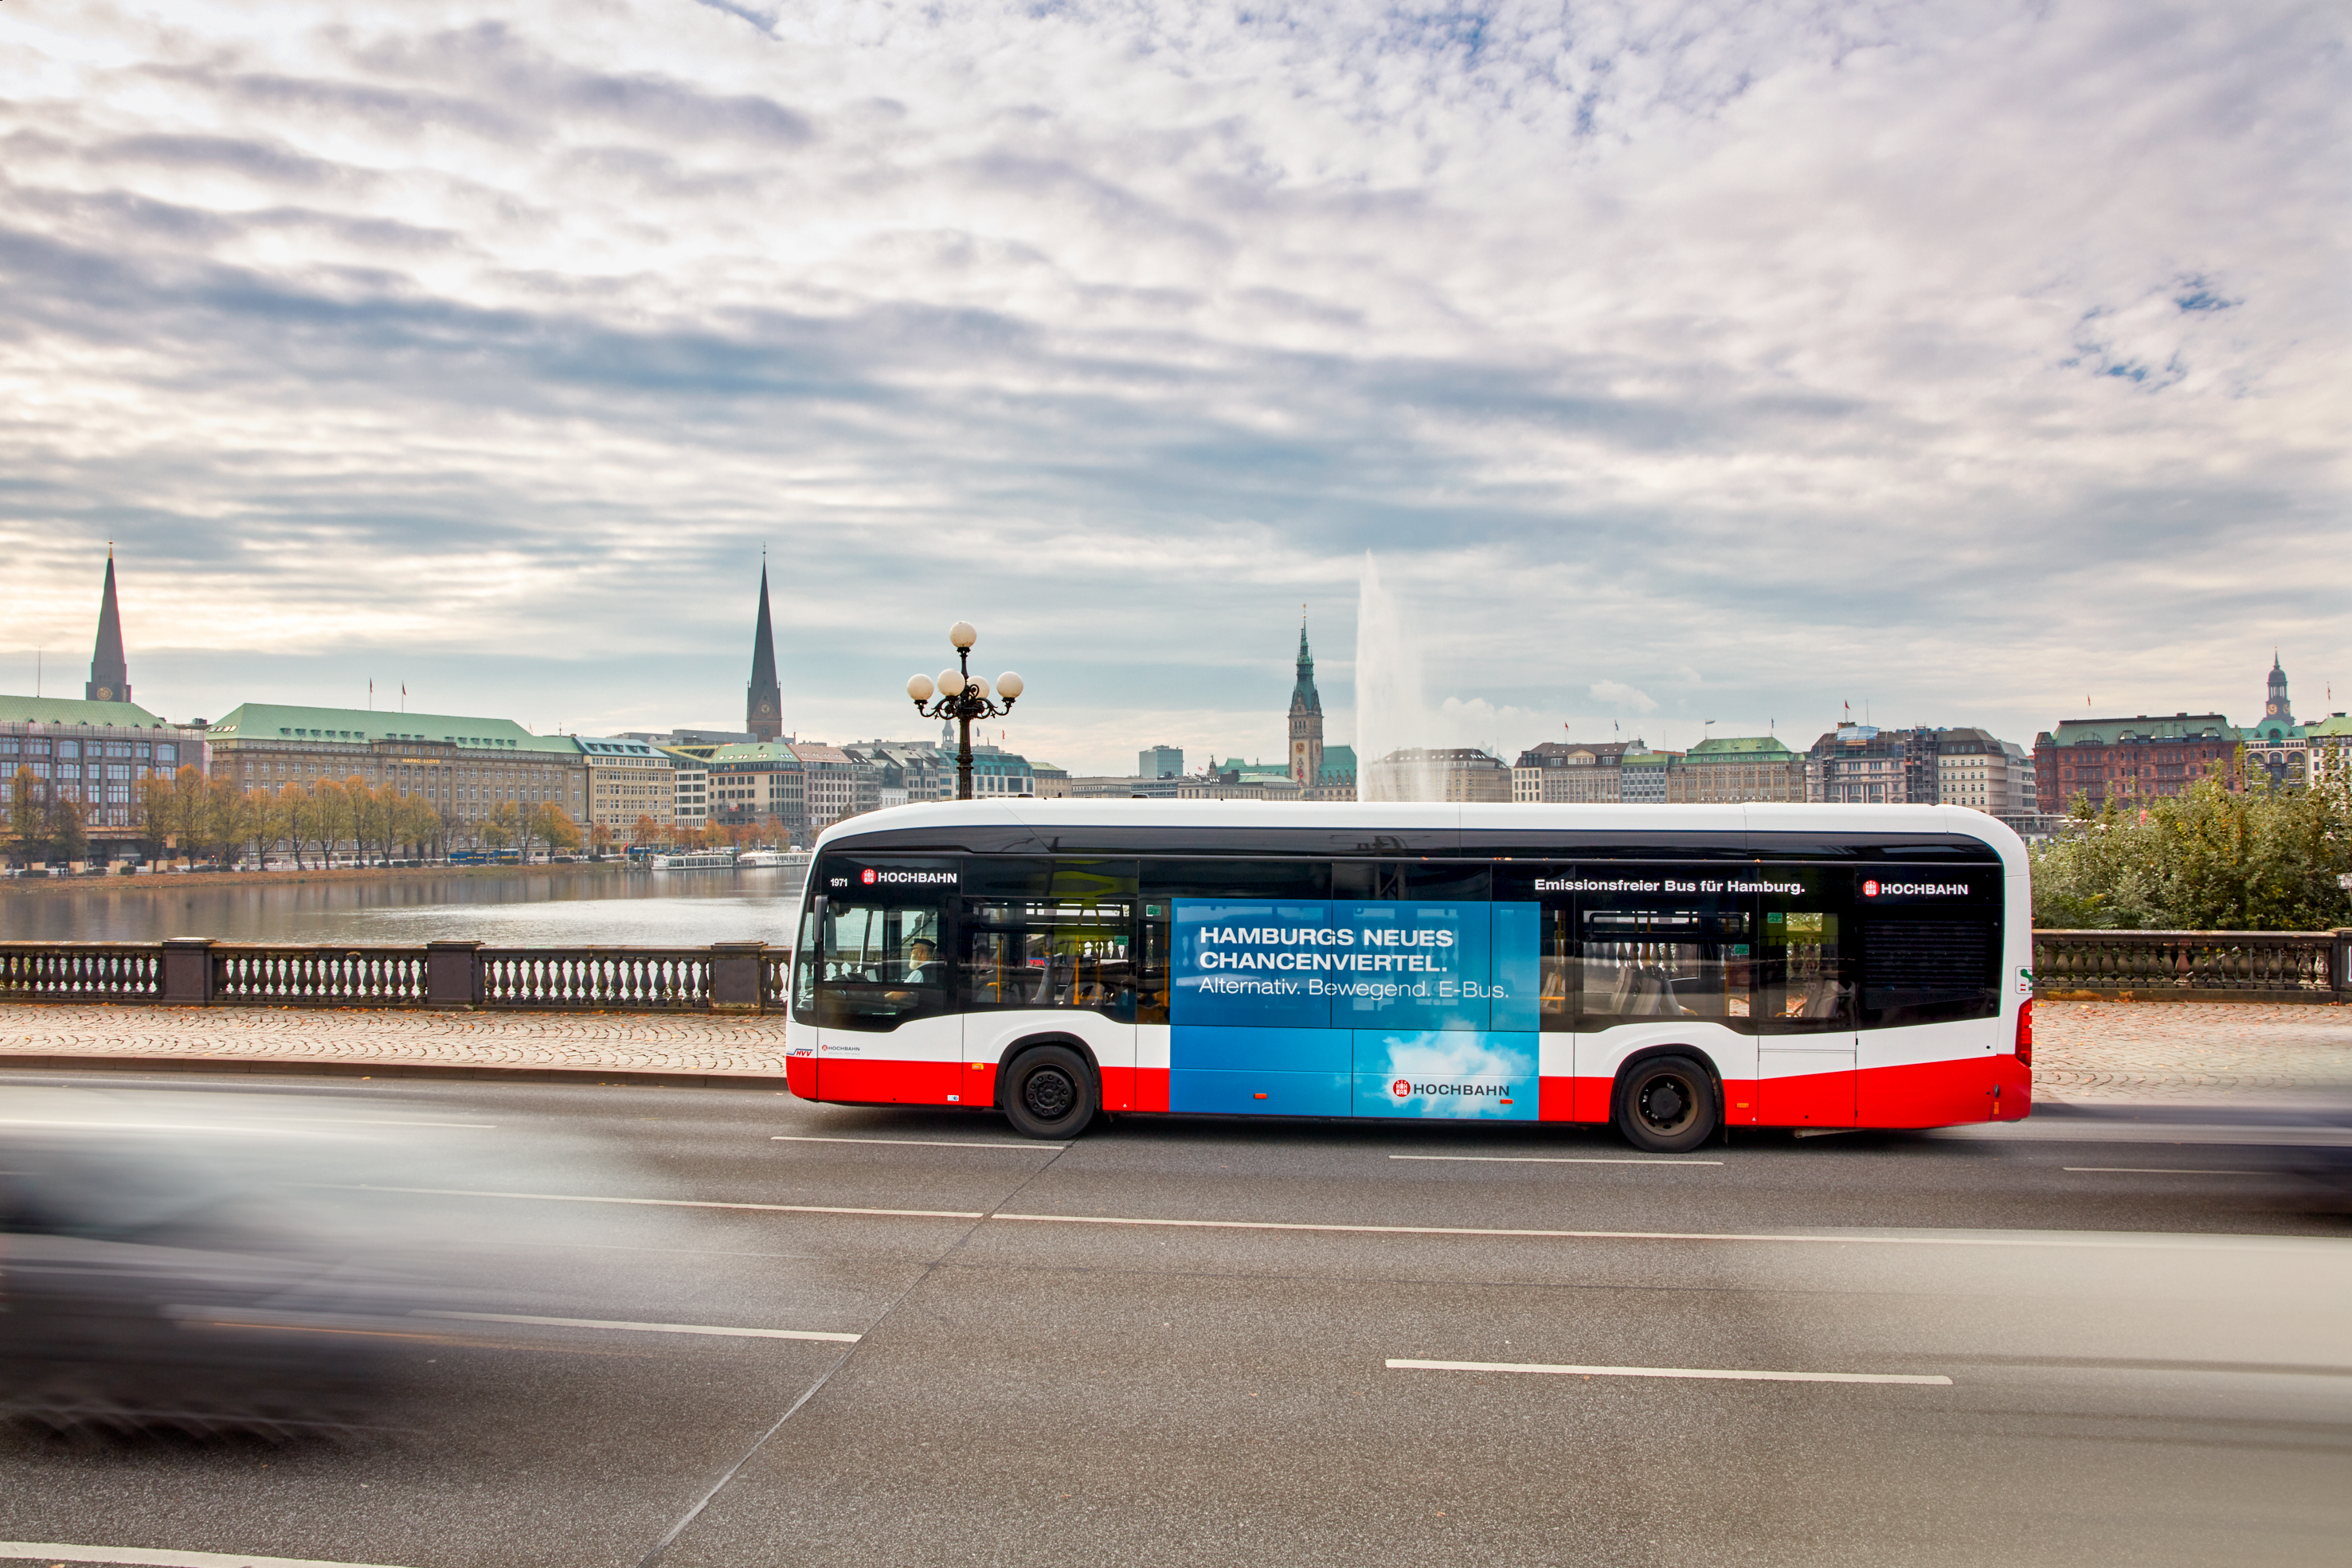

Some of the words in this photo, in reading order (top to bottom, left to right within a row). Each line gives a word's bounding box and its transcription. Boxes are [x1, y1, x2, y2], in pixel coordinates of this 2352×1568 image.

[830, 878, 848, 887] 1971
[877, 872, 957, 883] HOCHBAHN
[1534, 878, 1661, 891] Emissionsfreier
[1664, 880, 1696, 892] Bus
[1700, 880, 1724, 892] für
[1727, 880, 1806, 896] Hamburg.
[1880, 883, 1969, 895] HOCHBAHN
[1200, 926, 1354, 946] HAMBURGS
[1364, 929, 1454, 948] NEUES
[1199, 951, 1448, 972] CHANCENVIERTEL.
[1198, 976, 1301, 995] Alternativ.
[1308, 978, 1430, 1001] Bewegend.
[1438, 980, 1509, 999] E-Bus.
[1413, 1083, 1510, 1097] HOCHBAHN
